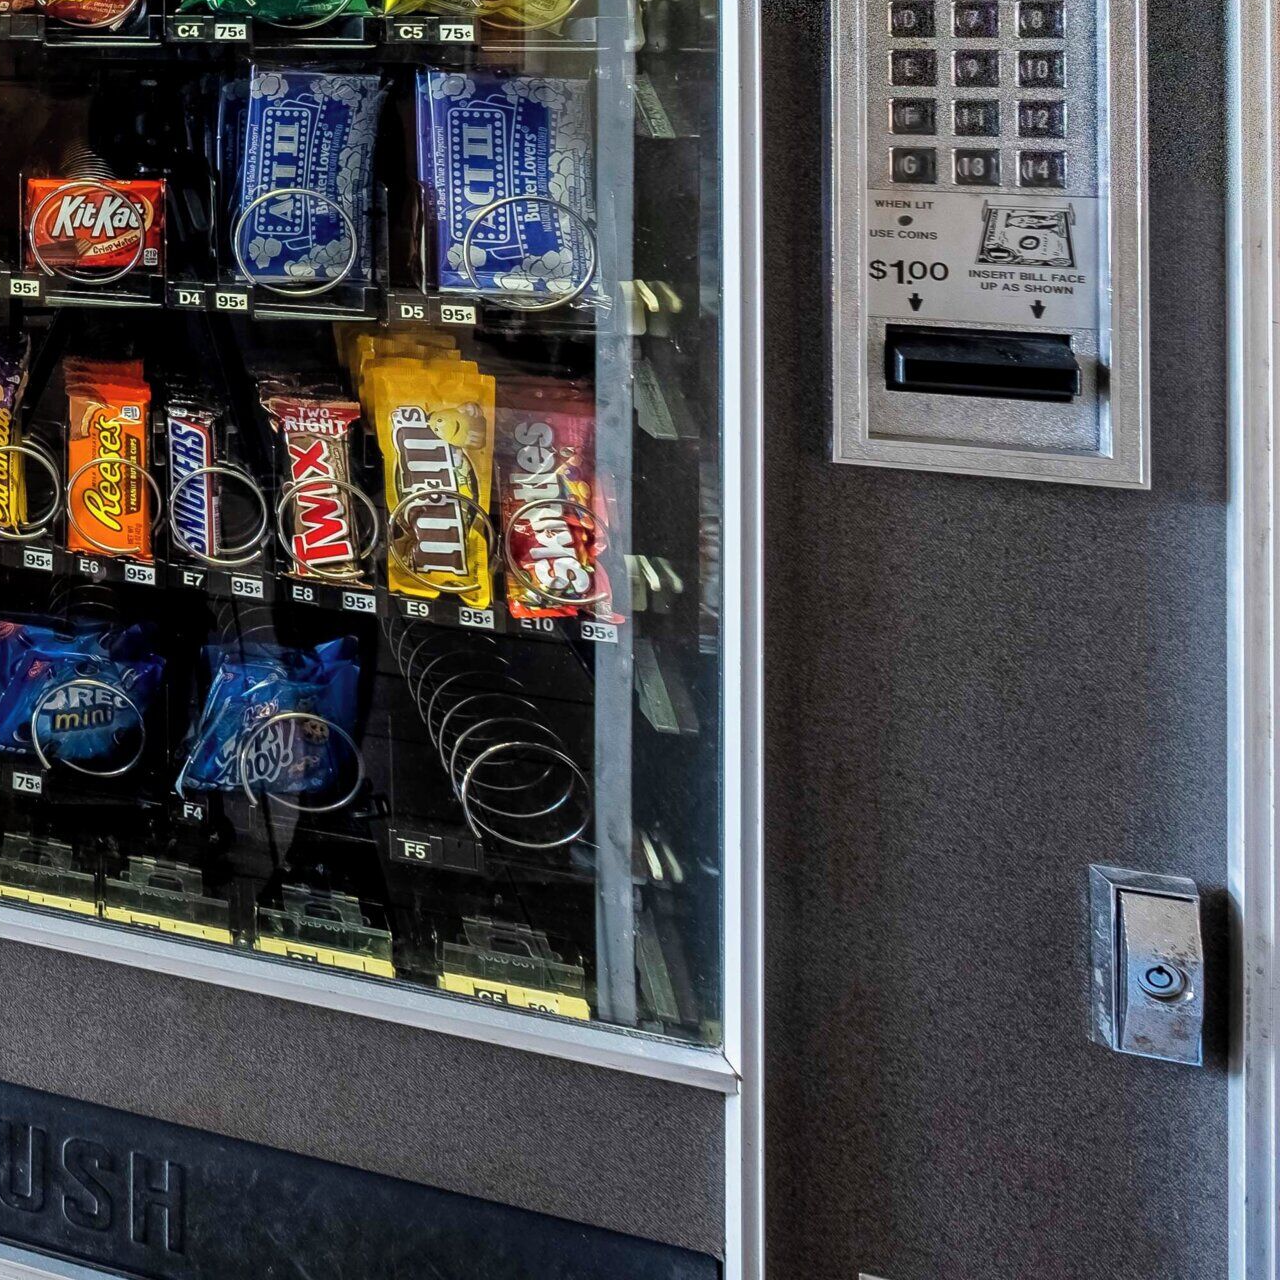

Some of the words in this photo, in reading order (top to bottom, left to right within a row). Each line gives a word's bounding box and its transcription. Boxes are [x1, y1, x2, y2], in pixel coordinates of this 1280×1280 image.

[177, 25, 199, 38] C4
[399, 27, 423, 39] C5
[462, 122, 493, 160] II
[316, 130, 334, 171] Lovers
[521, 132, 538, 177] Lovers
[875, 199, 912, 210] WHEN
[914, 200, 934, 210] LIT
[869, 229, 894, 240] USE
[897, 229, 938, 240] COINS
[93, 241, 113, 254] Crisp
[113, 233, 139, 251] Wafers
[869, 258, 949, 285] $1.00
[968, 269, 1015, 281] INSERT
[1020, 271, 1048, 283] BILL
[1051, 273, 1086, 284] FACE
[980, 282, 998, 292] UP
[1001, 282, 1021, 293] AS
[1023, 284, 1074, 295] SHOWN
[179, 292, 200, 305] D4
[401, 305, 424, 318] D5
[298, 407, 330, 418] TWO
[285, 417, 348, 436] RIGHT
[84, 414, 124, 533] Reese's
[130, 480, 138, 505] PEANUT
[170, 421, 207, 557] SNICKERS
[288, 440, 353, 576] TWIX
[509, 421, 591, 594] Skittles
[80, 561, 98, 573] E6
[183, 573, 204, 586] E7
[293, 587, 314, 600] E8
[406, 602, 429, 616] E9
[520, 619, 554, 632] E10
[55, 706, 113, 731] mini
[183, 804, 203, 820] F4
[403, 844, 427, 859] F5
